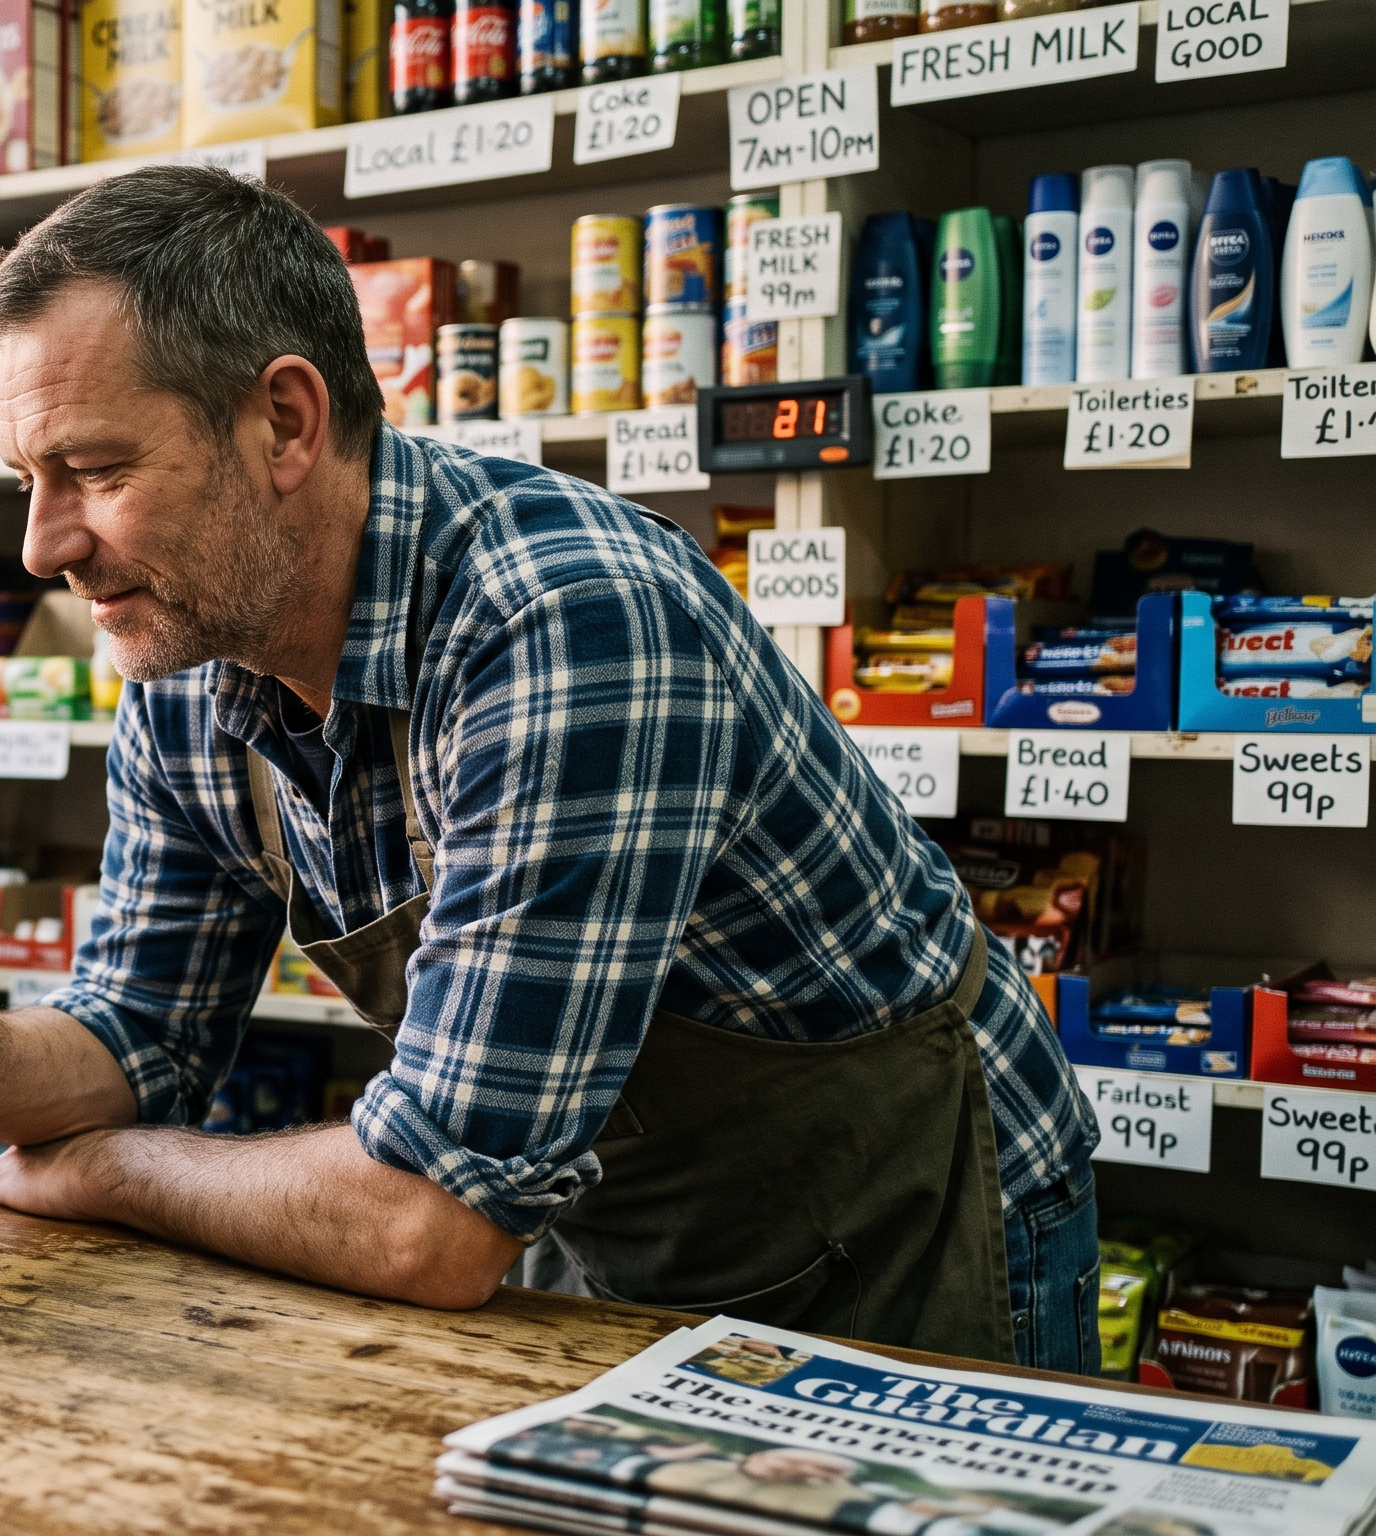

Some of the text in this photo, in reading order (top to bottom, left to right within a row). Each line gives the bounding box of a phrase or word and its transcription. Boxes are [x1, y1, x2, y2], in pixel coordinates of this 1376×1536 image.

[1165, 0, 1270, 31] LOCAL
[899, 20, 1127, 86] FRESH MILK
[1170, 32, 1265, 68] GOOD
[587, 82, 650, 112] Coke
[747, 80, 847, 125] OPEN
[354, 131, 435, 174] Local
[738, 126, 875, 172] 7AM-10PM
[753, 223, 831, 253] FRESH
[759, 254, 819, 275] MILK
[882, 399, 964, 428] Coke
[1073, 388, 1190, 415] Toilerties
[615, 417, 688, 445] Bread
[755, 540, 837, 563] LOCAL
[755, 573, 839, 599] GOODS
[1018, 739, 1109, 768] Bread
[1239, 743, 1364, 774] Sweets
[1267, 781, 1336, 820] 99p
[1268, 1097, 1376, 1134] Sweet
[1111, 1115, 1179, 1159] 99p
[1296, 1137, 1370, 1184] 99p
[660, 1372, 753, 1408] The
[881, 1374, 1026, 1416] The
[793, 1377, 1180, 1462] Guardian
